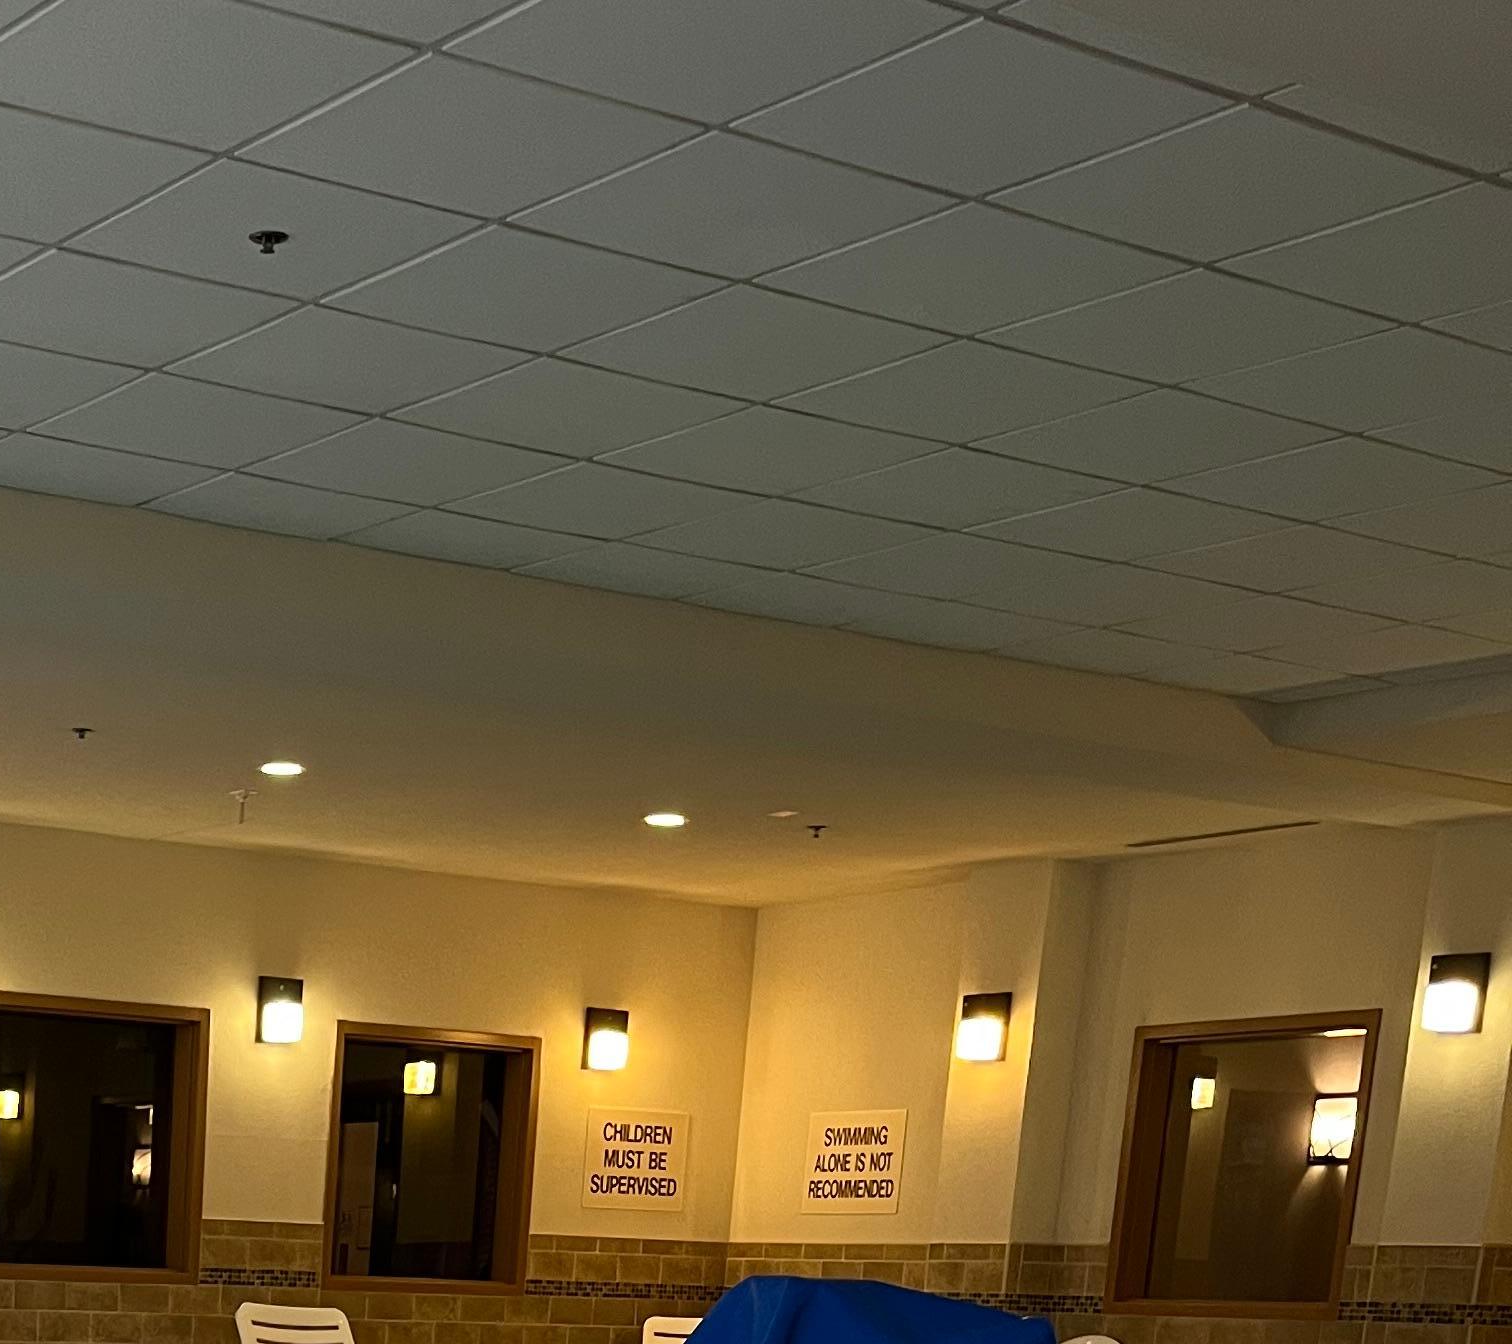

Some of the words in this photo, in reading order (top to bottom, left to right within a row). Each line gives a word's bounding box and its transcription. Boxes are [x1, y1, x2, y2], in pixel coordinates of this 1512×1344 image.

[603, 1122, 673, 1145] CHILDREN
[824, 1126, 889, 1147] SWIMMING
[603, 1149, 645, 1169] MUST
[648, 1151, 668, 1171] BE
[814, 1153, 852, 1173] ALONE
[855, 1153, 866, 1173] IS
[869, 1151, 894, 1172] NOT
[589, 1174, 678, 1197] SUPERVISED
[808, 1178, 895, 1199] RECOMMENDED
